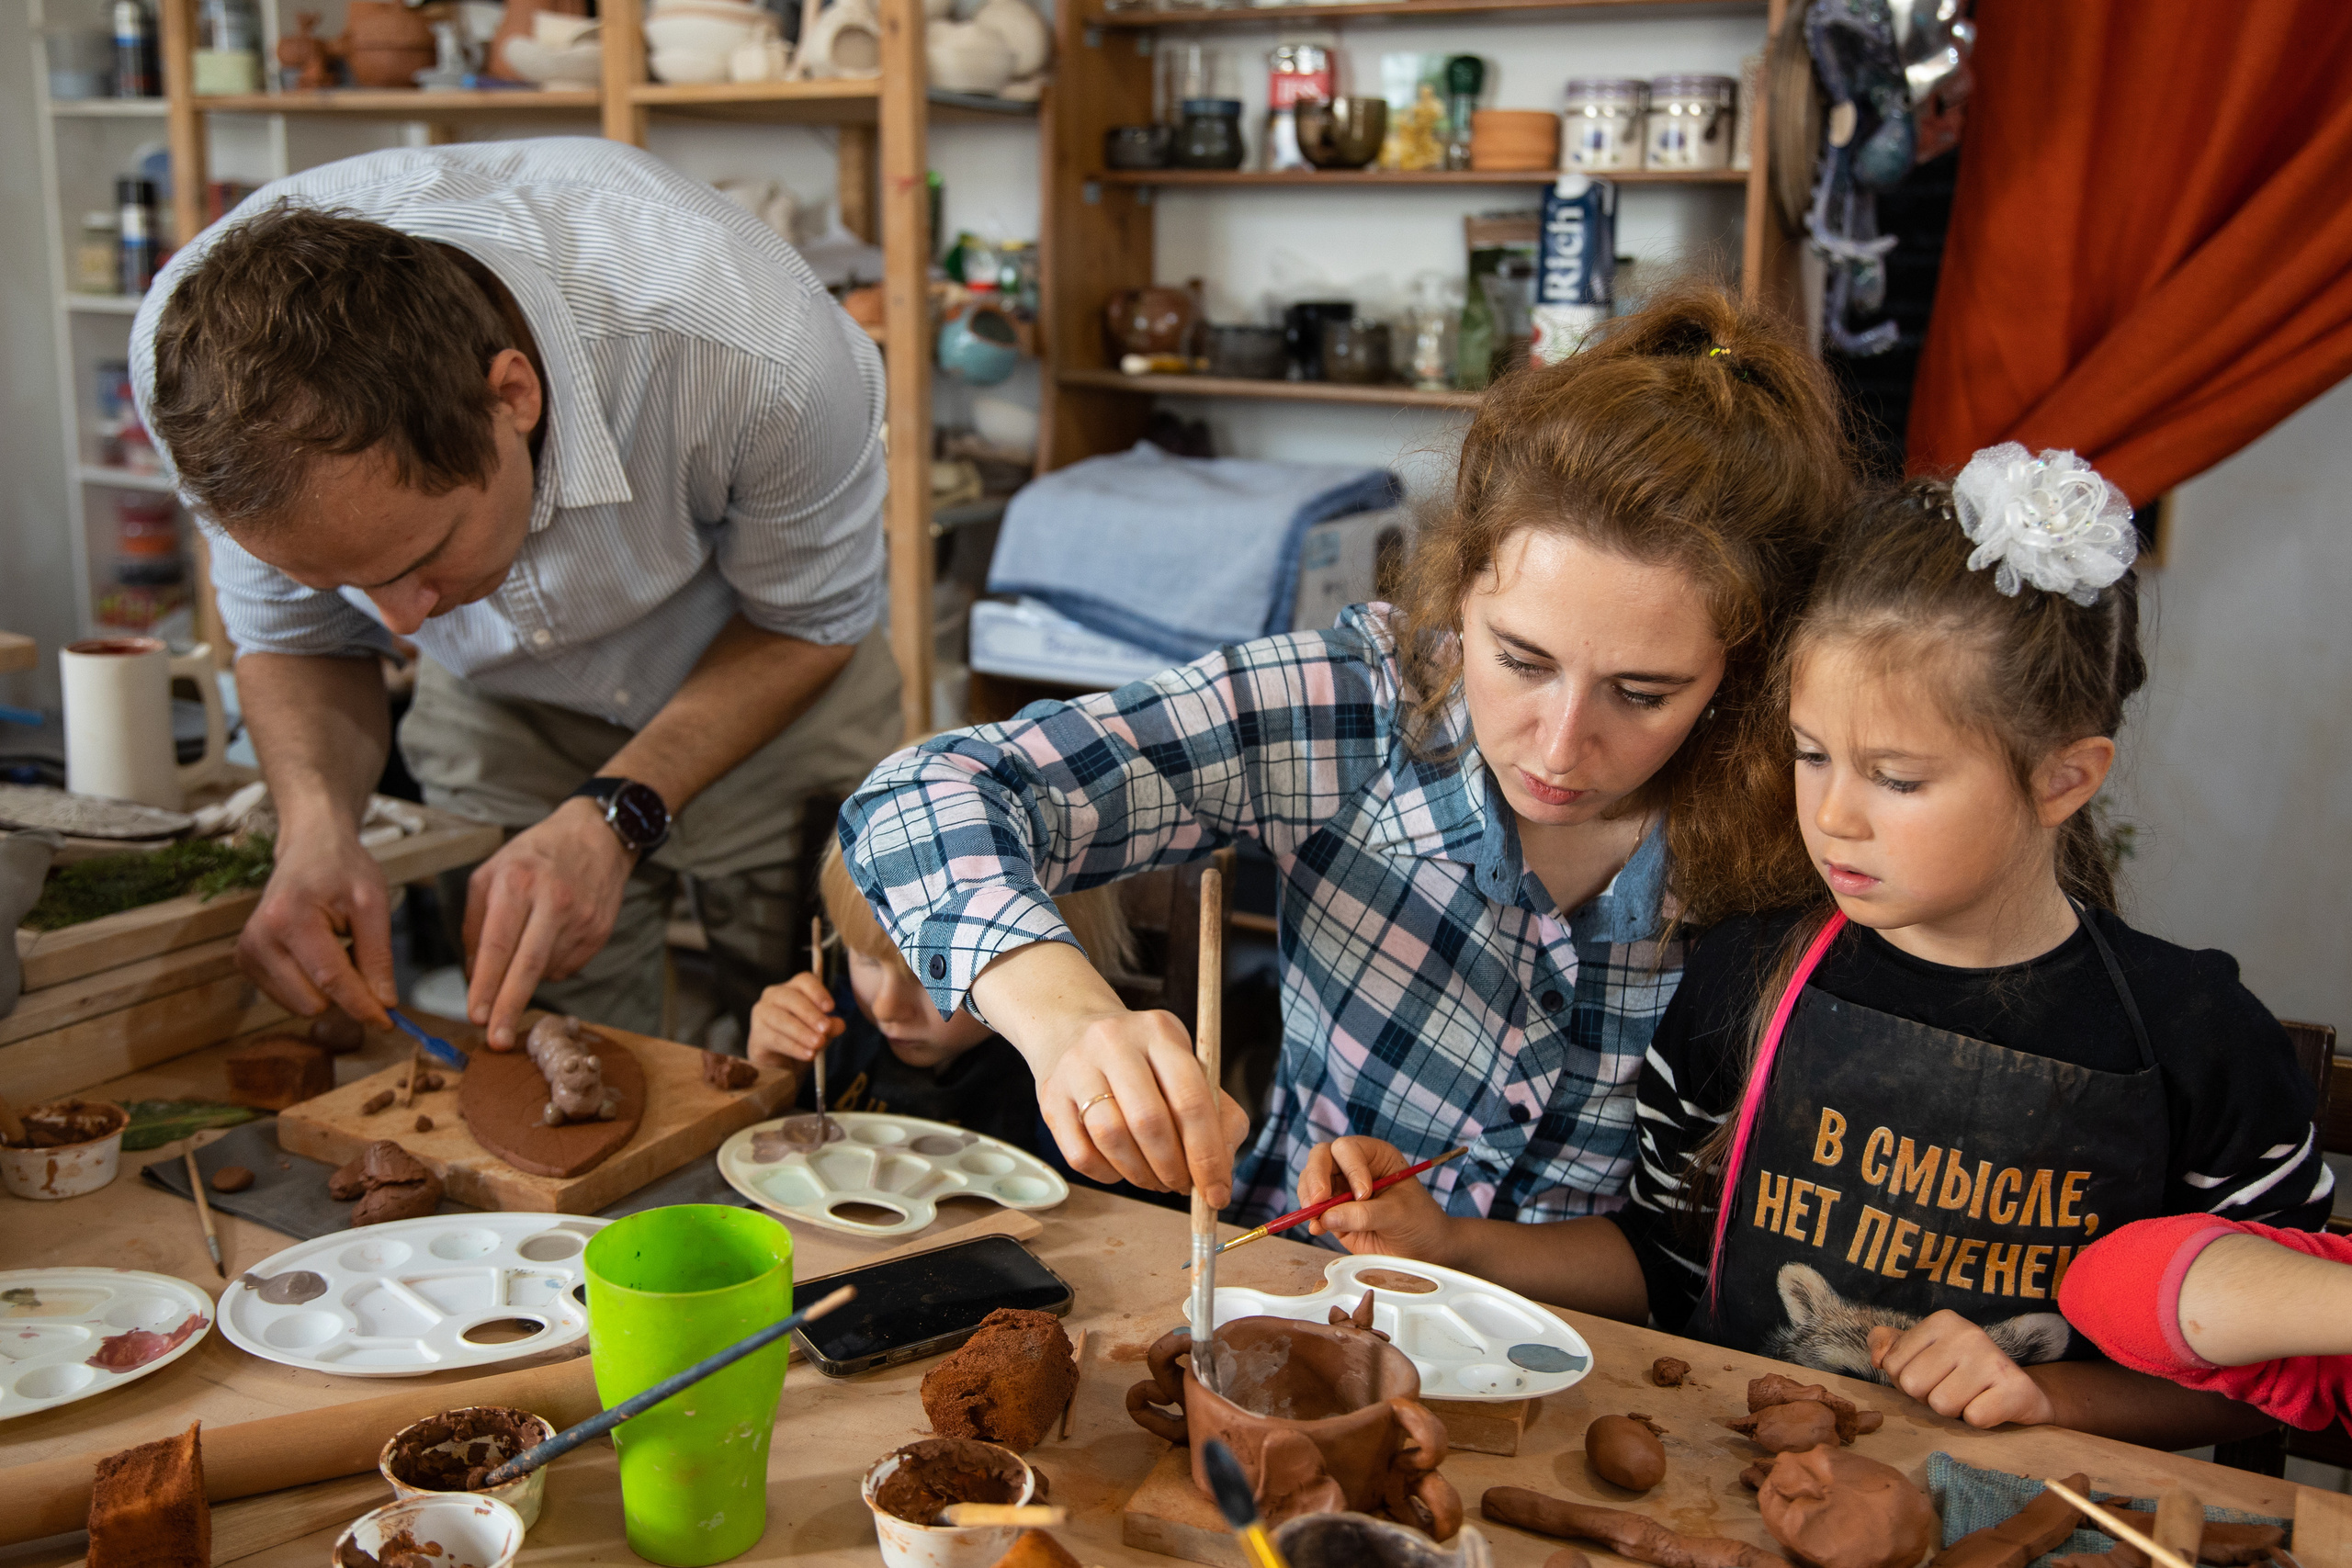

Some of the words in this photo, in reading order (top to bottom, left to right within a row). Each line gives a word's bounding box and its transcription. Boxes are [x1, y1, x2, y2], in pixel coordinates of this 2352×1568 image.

[1544, 206, 1585, 300] Rich
[1753, 1169, 1842, 1247] НЕТ
[1813, 1107, 1848, 1167] В
[1861, 1126, 2099, 1236] СМЫСЛЕ,
